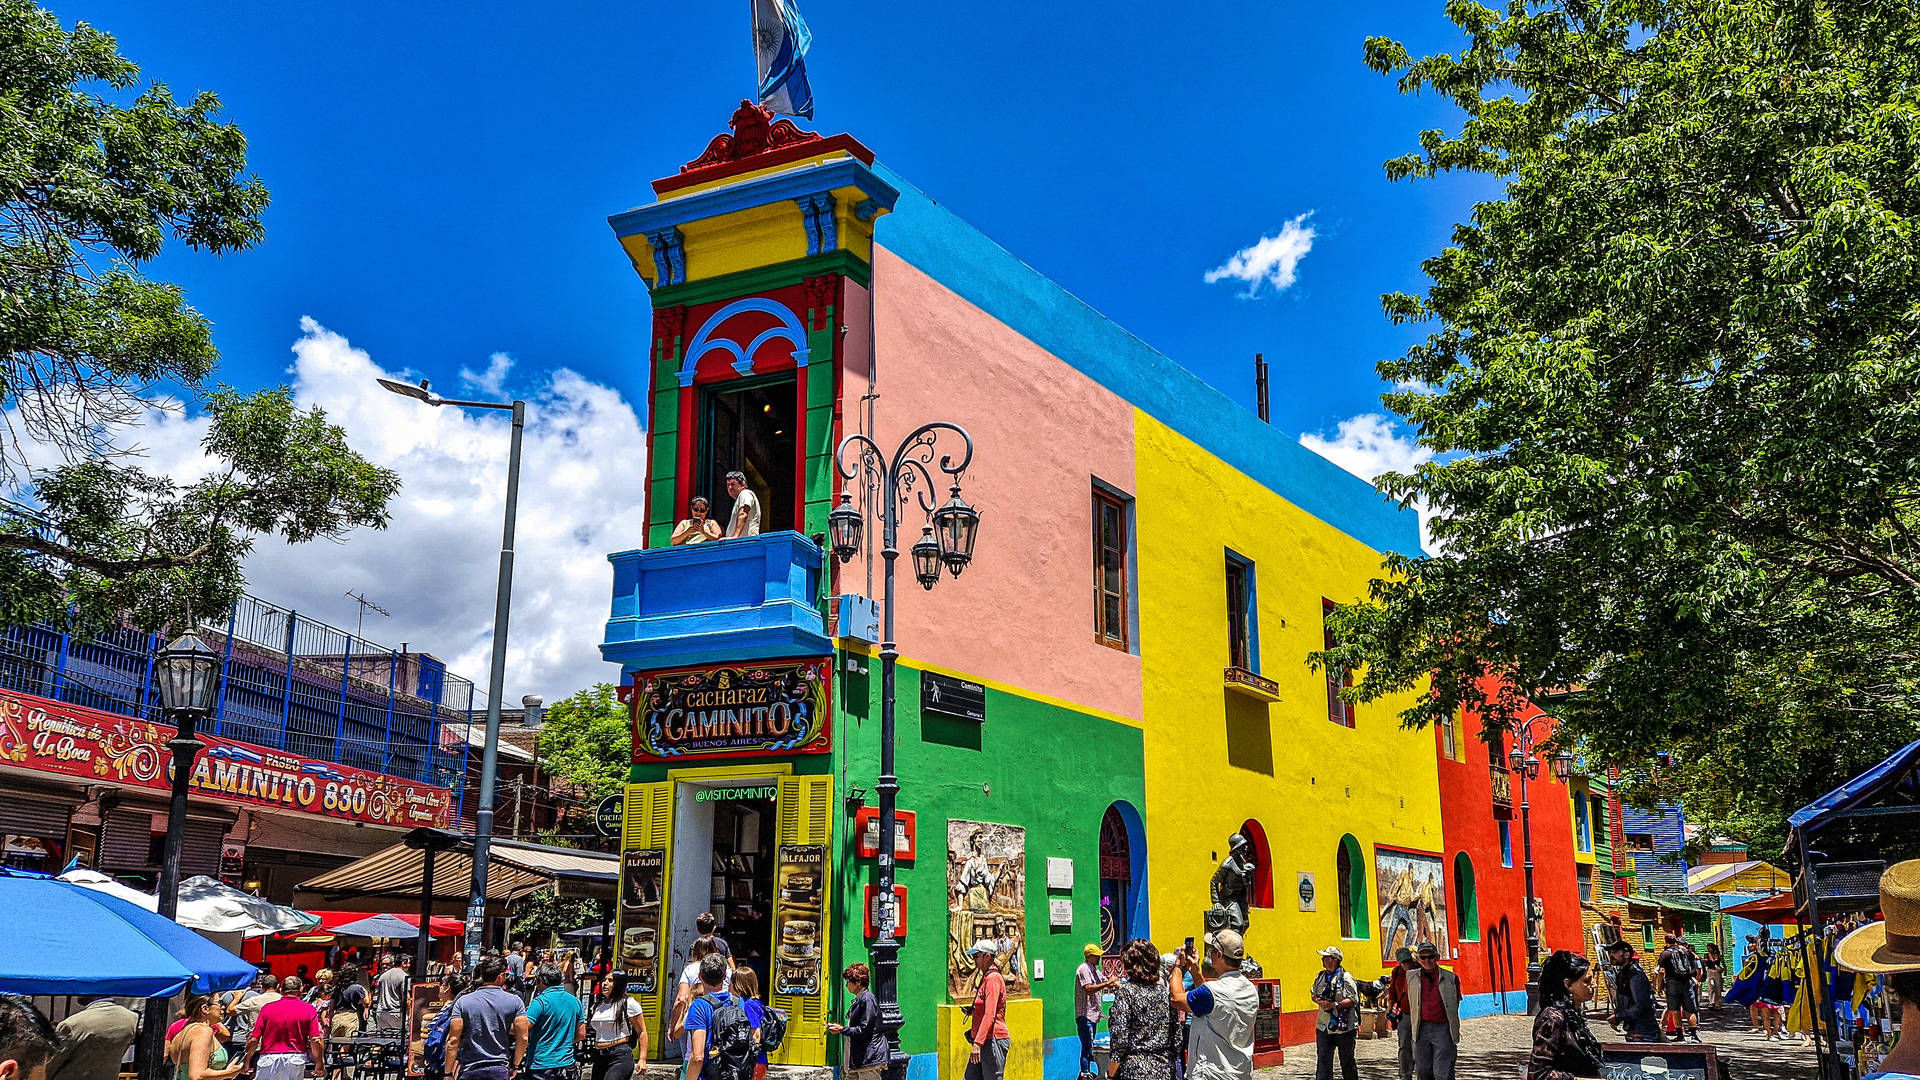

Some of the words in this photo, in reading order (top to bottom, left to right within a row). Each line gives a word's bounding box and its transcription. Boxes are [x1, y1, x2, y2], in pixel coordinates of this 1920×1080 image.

[664, 702, 791, 741] CAMINITO
[87, 722, 102, 740] de
[33, 732, 56, 756] La
[56, 736, 91, 762] Boca
[692, 740, 728, 748] BUENOS
[731, 738, 758, 746] AIRES
[264, 753, 299, 770] PASEO
[169, 756, 316, 806] AMINITO
[322, 782, 366, 815] 830
[695, 786, 777, 803] @VISITCAMINITO
[627, 858, 661, 867] ALFAJOR
[783, 854, 821, 863] ALFAJOR
